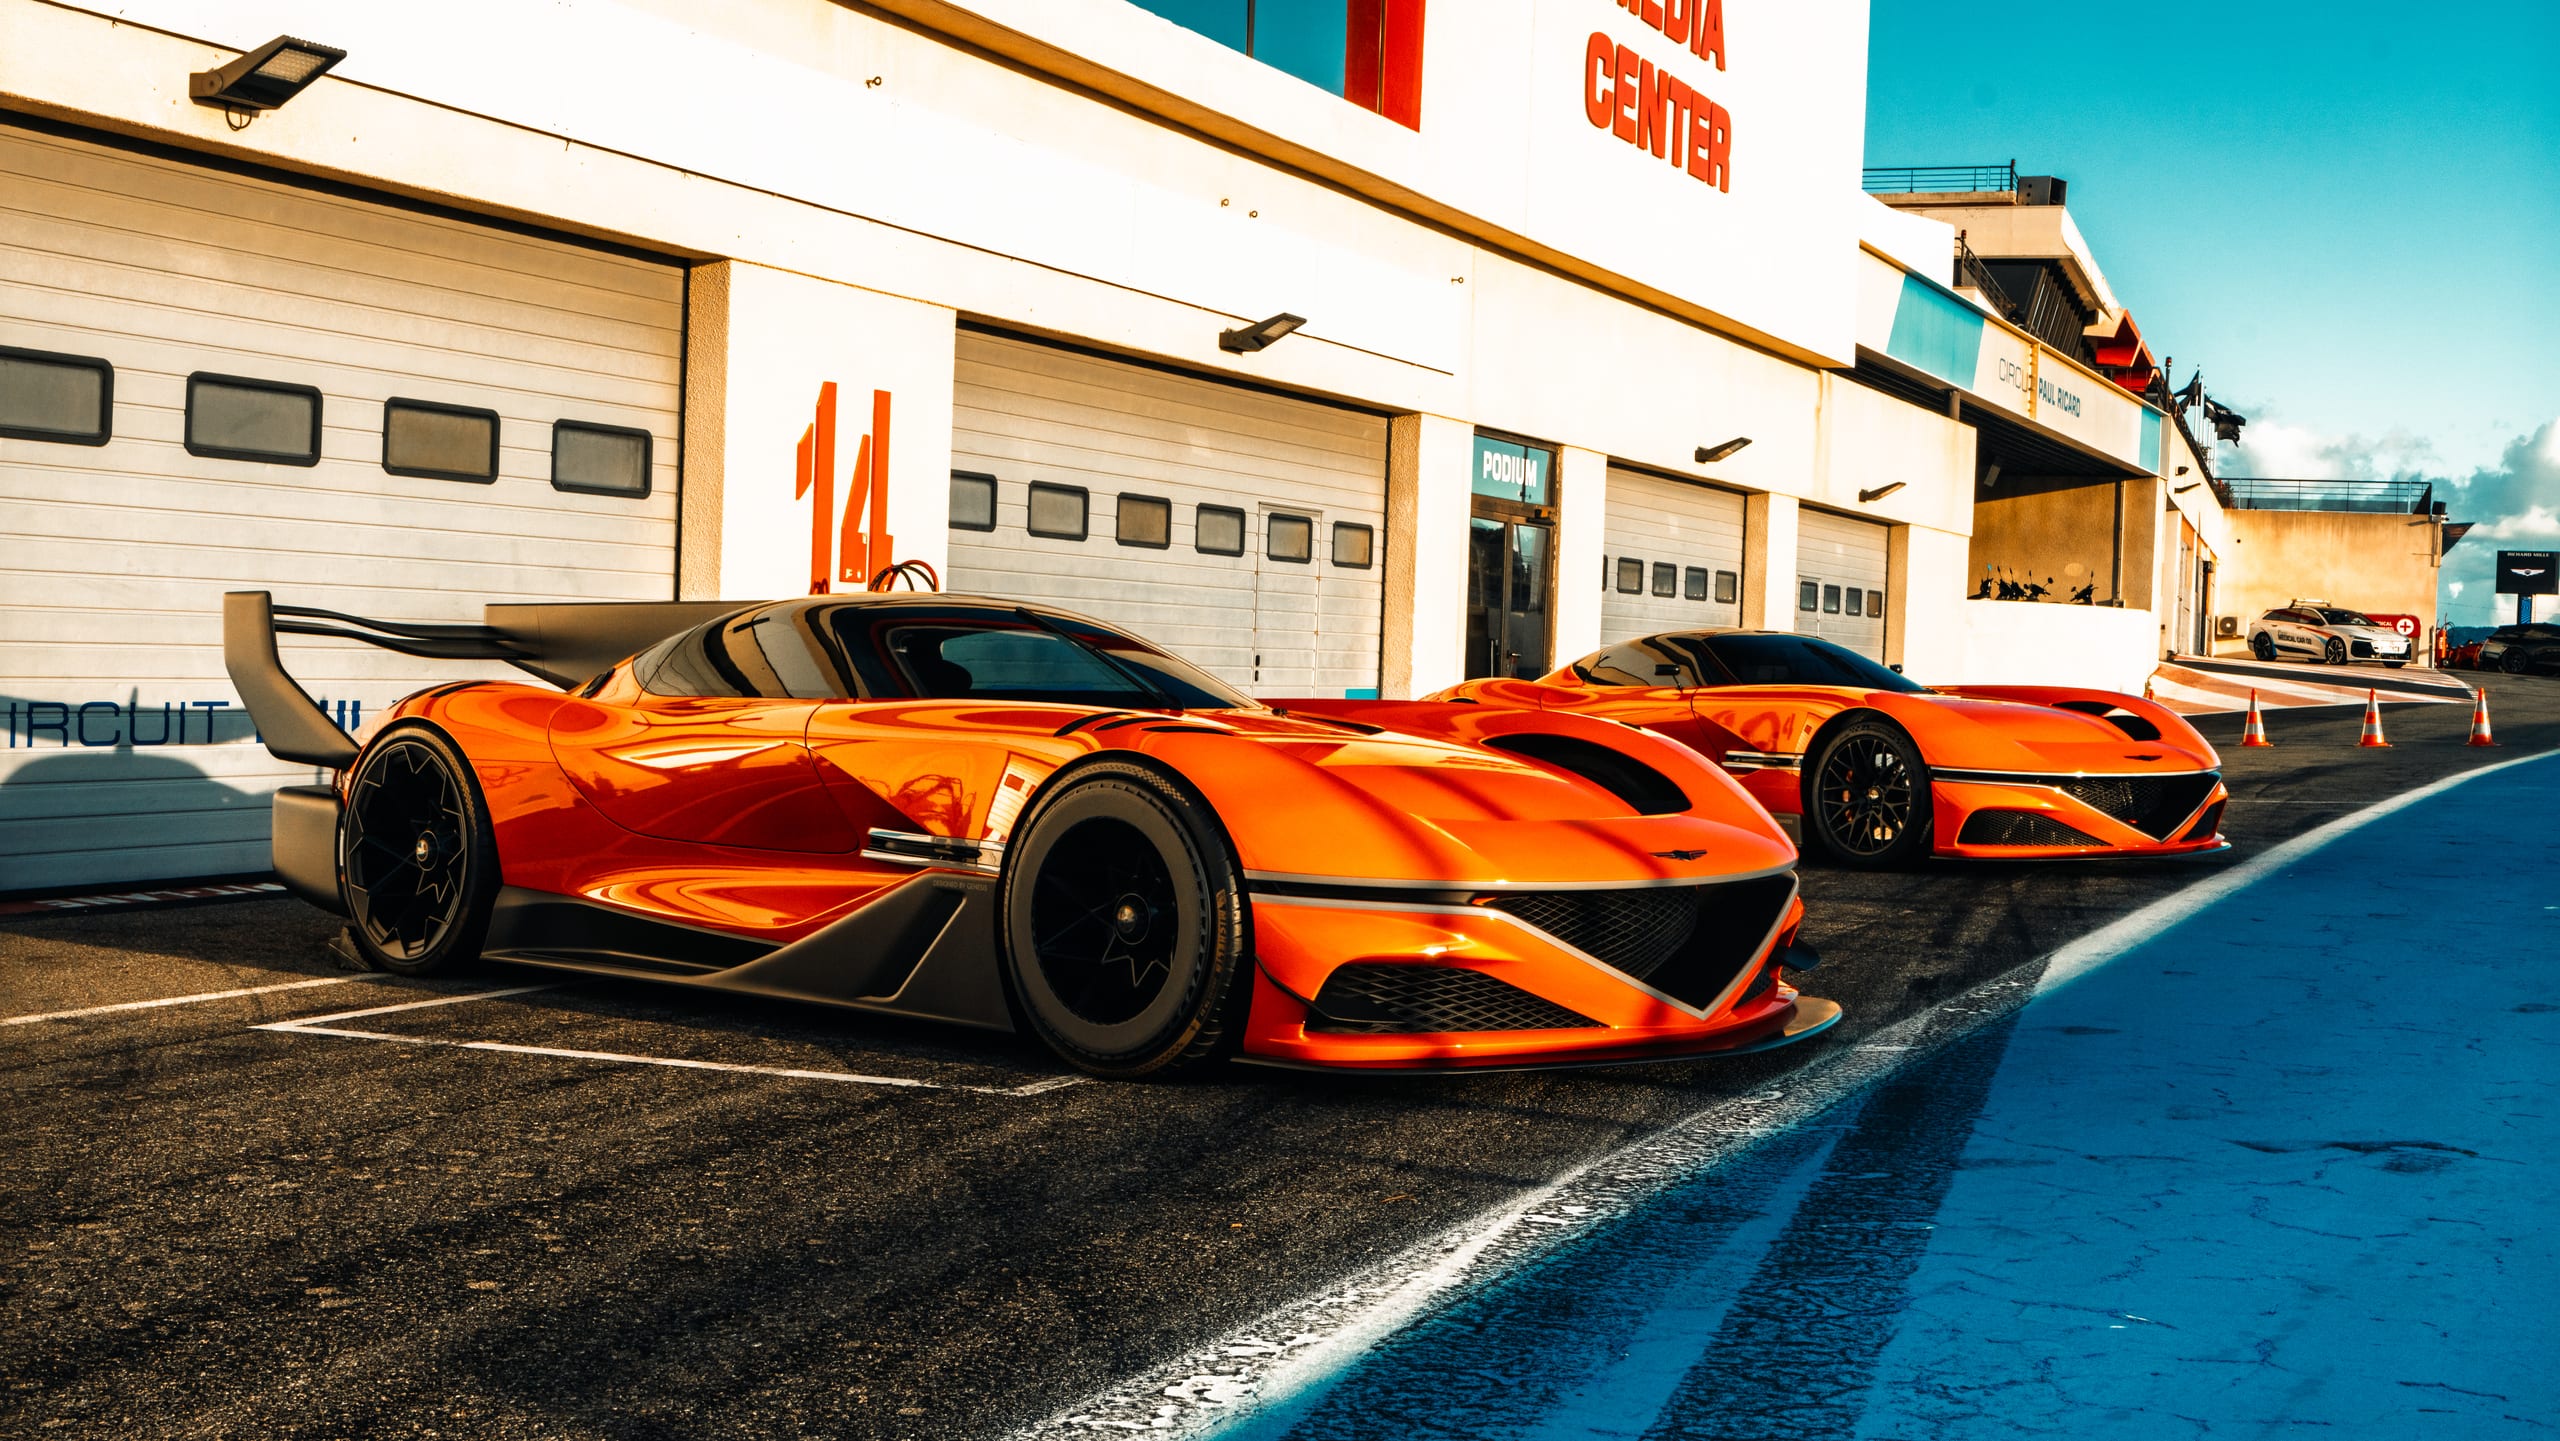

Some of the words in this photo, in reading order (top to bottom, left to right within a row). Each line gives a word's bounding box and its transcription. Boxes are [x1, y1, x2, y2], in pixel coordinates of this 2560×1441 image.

[1585, 31, 1732, 193] CENTER
[1999, 357, 2029, 393] CIRCU
[2038, 376, 2055, 405] PAUL
[2058, 387, 2081, 418] RICARD
[795, 380, 894, 596] 14
[1482, 450, 1538, 487] PODIUM
[8, 700, 230, 748] IRCUIT
